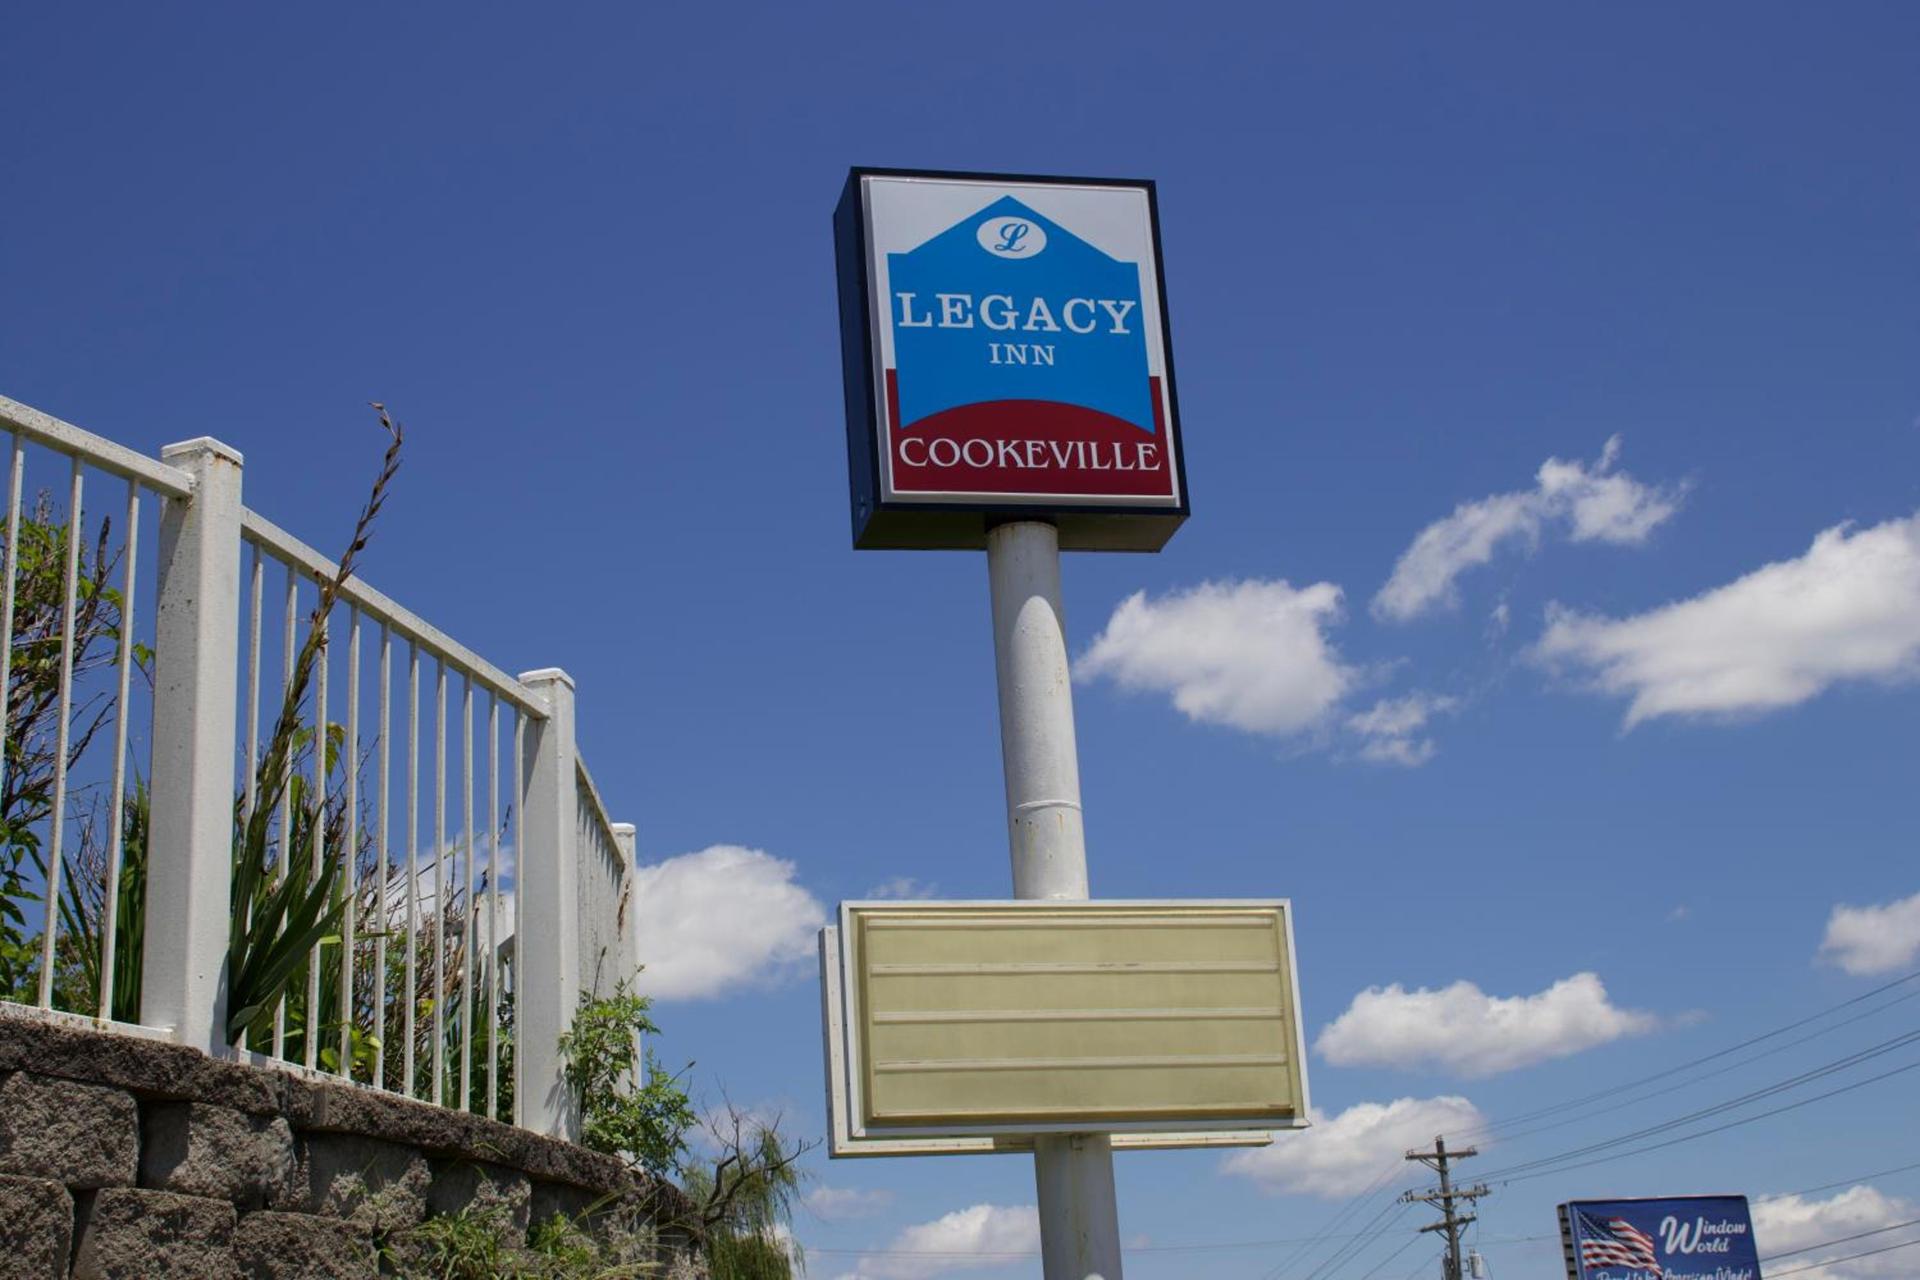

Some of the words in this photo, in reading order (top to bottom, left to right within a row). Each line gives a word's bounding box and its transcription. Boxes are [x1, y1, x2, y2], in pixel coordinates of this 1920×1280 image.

[994, 223, 1028, 252] L
[896, 292, 1136, 334] LEGACY
[989, 343, 1055, 366] INN
[899, 438, 1161, 471] COOKEVILLE
[1660, 1216, 1746, 1254] Window
